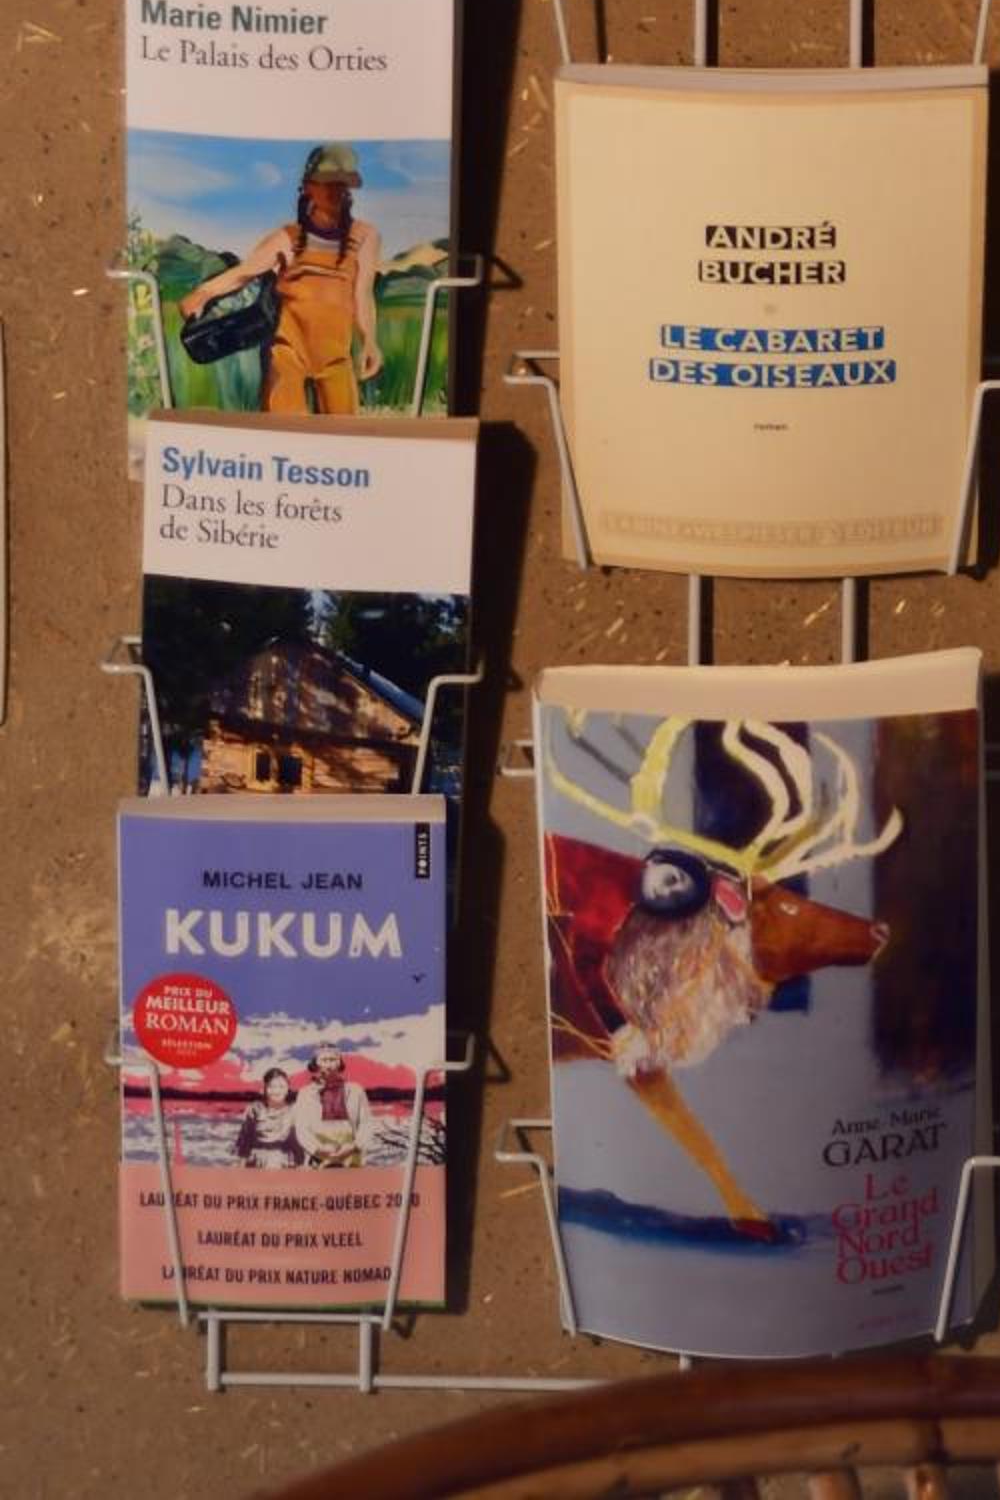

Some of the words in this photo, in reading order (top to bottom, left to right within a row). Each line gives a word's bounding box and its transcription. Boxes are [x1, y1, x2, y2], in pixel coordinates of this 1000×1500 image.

[231, 4, 329, 35] Nimier
[141, 35, 170, 62] Le
[180, 39, 249, 70] Palais
[258, 44, 300, 70] des
[308, 45, 388, 72] Orties
[707, 221, 836, 250] ANDRÉ
[701, 260, 845, 285] BUCHER
[663, 324, 701, 350] LE
[714, 326, 884, 353] CABARET
[652, 358, 719, 386] DES
[731, 359, 894, 388] OISEAUX
[162, 446, 263, 481] Sylvain
[272, 456, 370, 488] Tesson
[161, 484, 227, 514] Dans
[236, 489, 265, 517] les
[274, 493, 342, 523] forêts
[160, 515, 189, 541] de
[197, 519, 280, 549] Sibérie
[203, 870, 290, 890] MICHEL
[302, 872, 362, 891] JEAN
[164, 908, 402, 958] KUKUM
[146, 995, 230, 1014] MEILLEUR
[146, 1012, 229, 1035] ROMAN
[823, 1122, 947, 1168] GARAT
[140, 1191, 198, 1208] LAUÉAT
[204, 1195, 222, 1209] DU
[227, 1195, 259, 1211] PRIX
[386, 1192, 420, 1208] 200
[865, 1172, 909, 1200] Le
[832, 1187, 939, 1229] Grand
[197, 1229, 255, 1246] LAURÉAT
[261, 1232, 280, 1246] DU
[285, 1233, 318, 1247] PRIX
[322, 1231, 363, 1248] VLEEL
[838, 1212, 920, 1256] Nord
[225, 1267, 243, 1283] DU
[249, 1268, 280, 1284] PRIX
[286, 1269, 338, 1285] NATURE
[343, 1266, 391, 1284] NOMAD
[837, 1241, 932, 1284] Ouest
